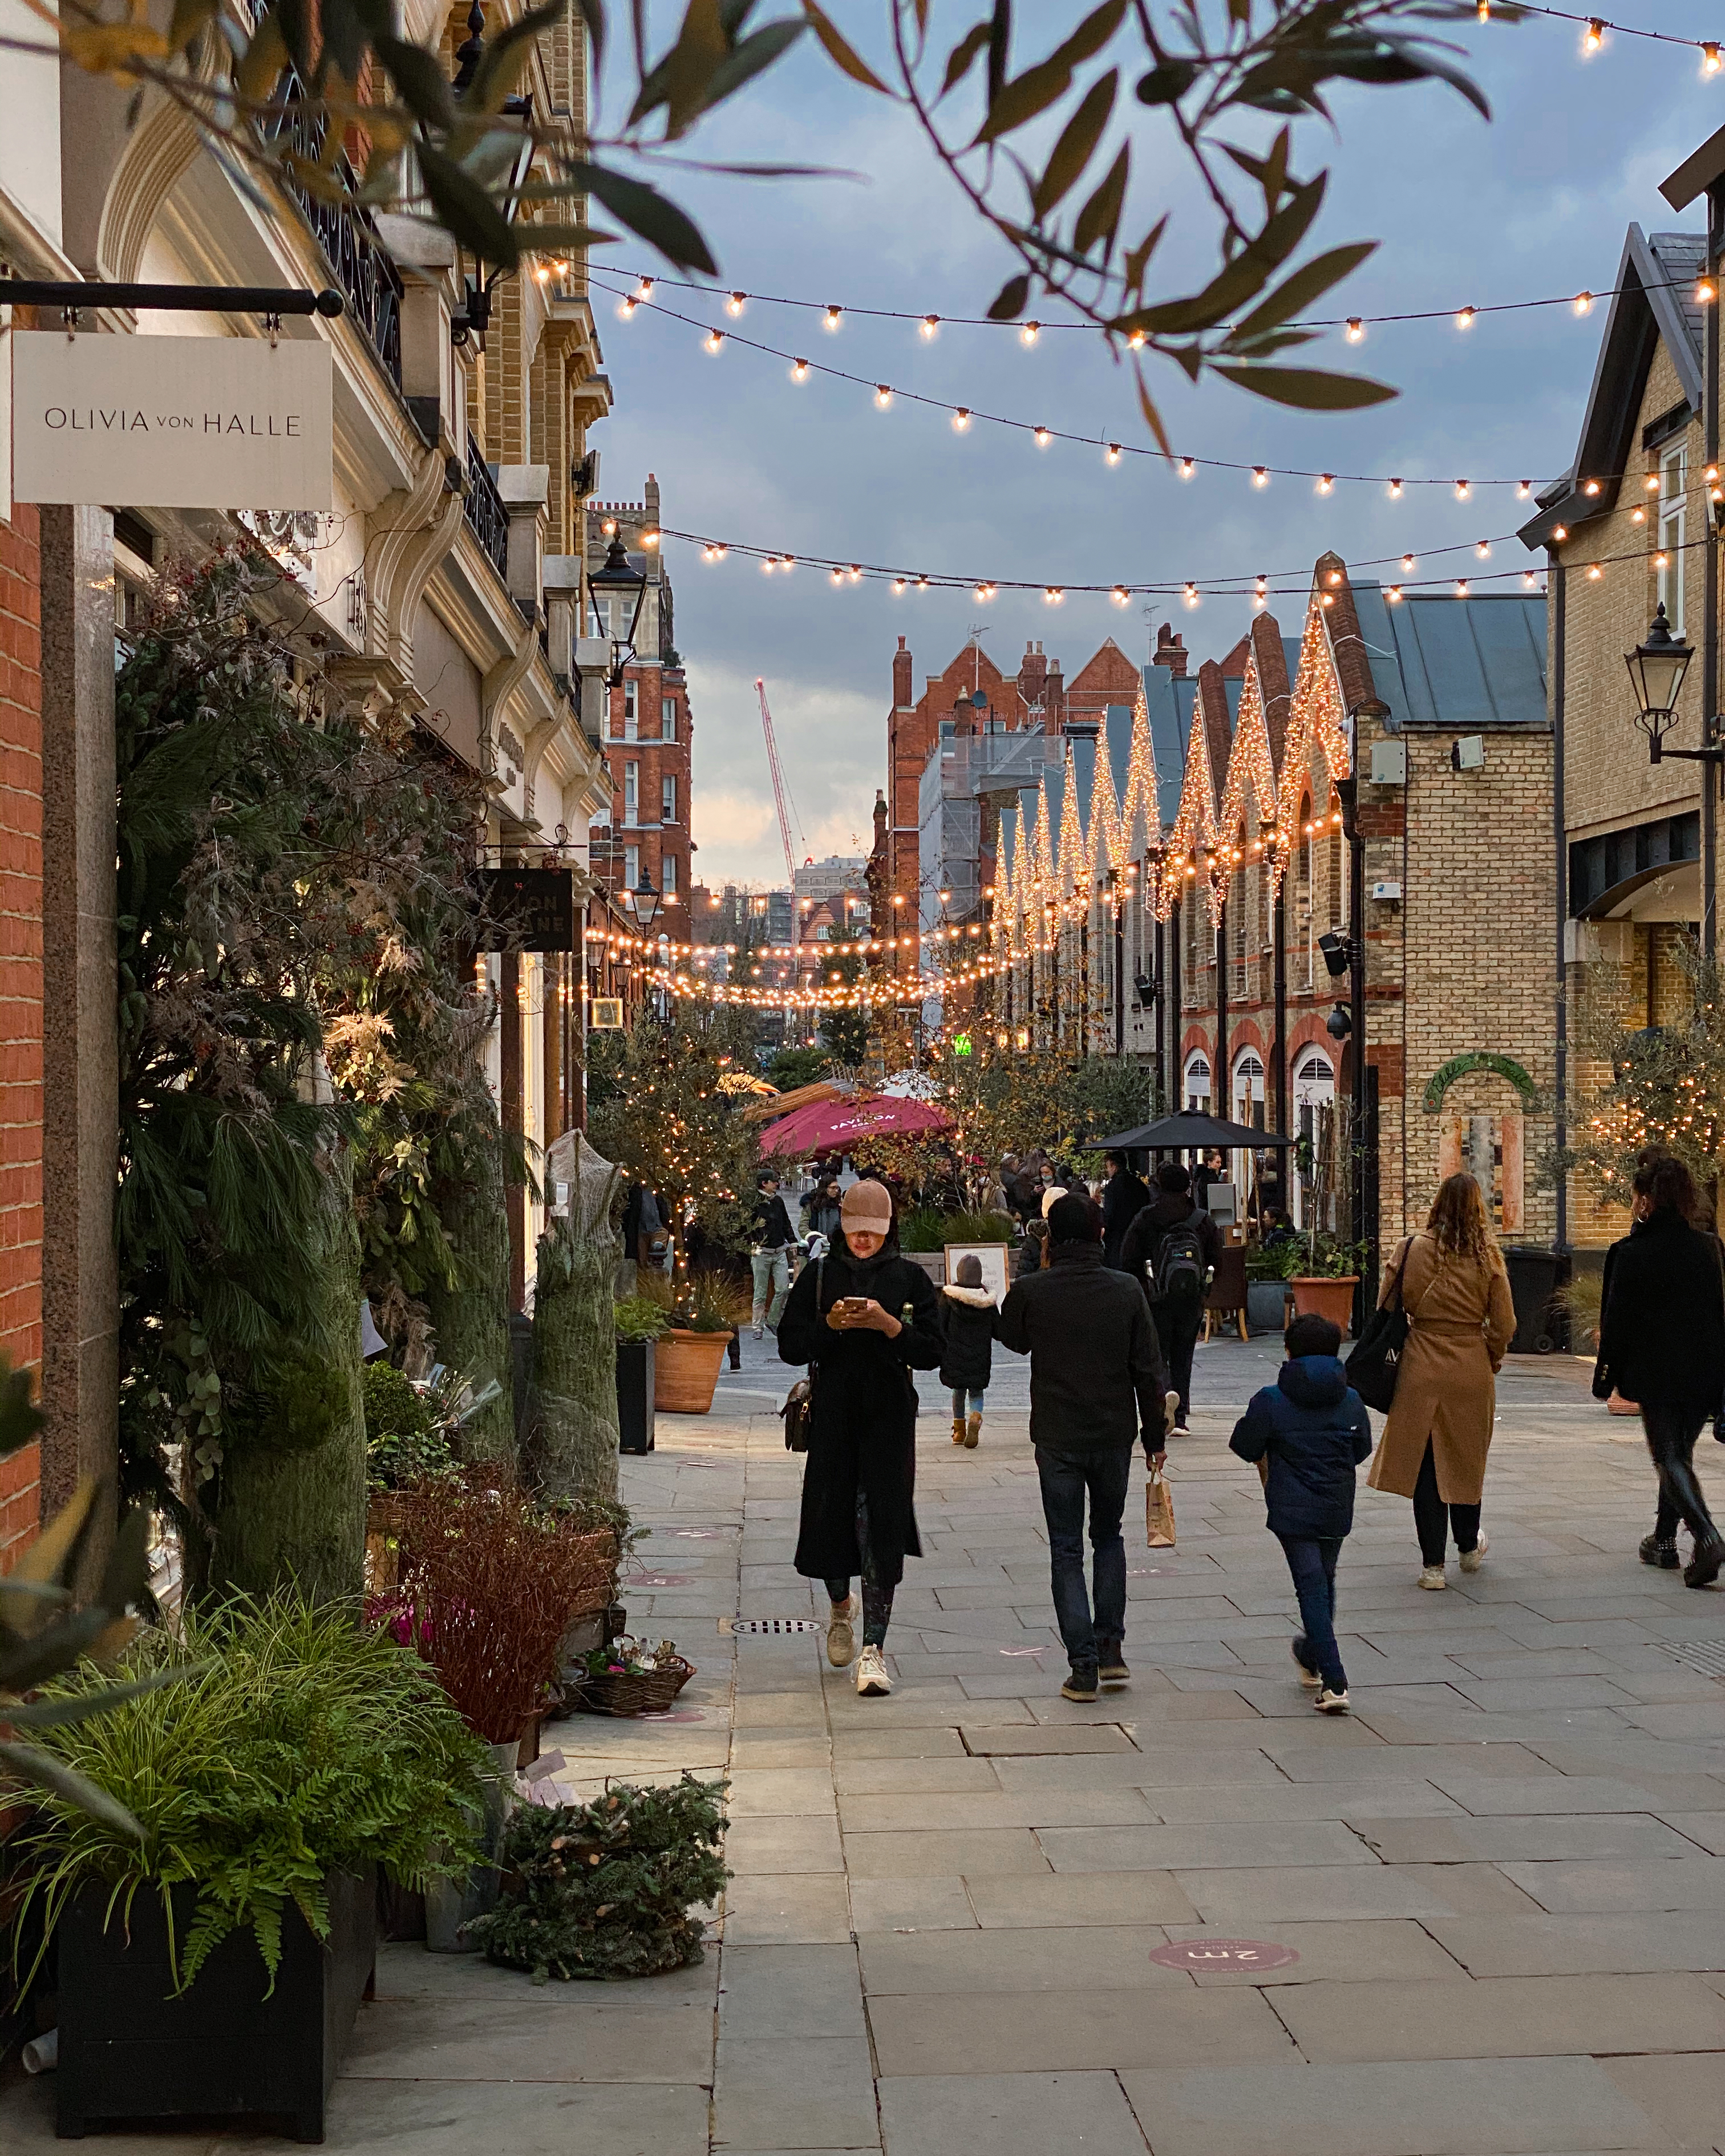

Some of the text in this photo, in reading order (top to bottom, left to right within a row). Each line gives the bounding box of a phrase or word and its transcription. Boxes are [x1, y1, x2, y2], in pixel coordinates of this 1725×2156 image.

[44, 407, 301, 437] OLIVIA VON HALLE
[830, 1114, 896, 1130] PAVION
